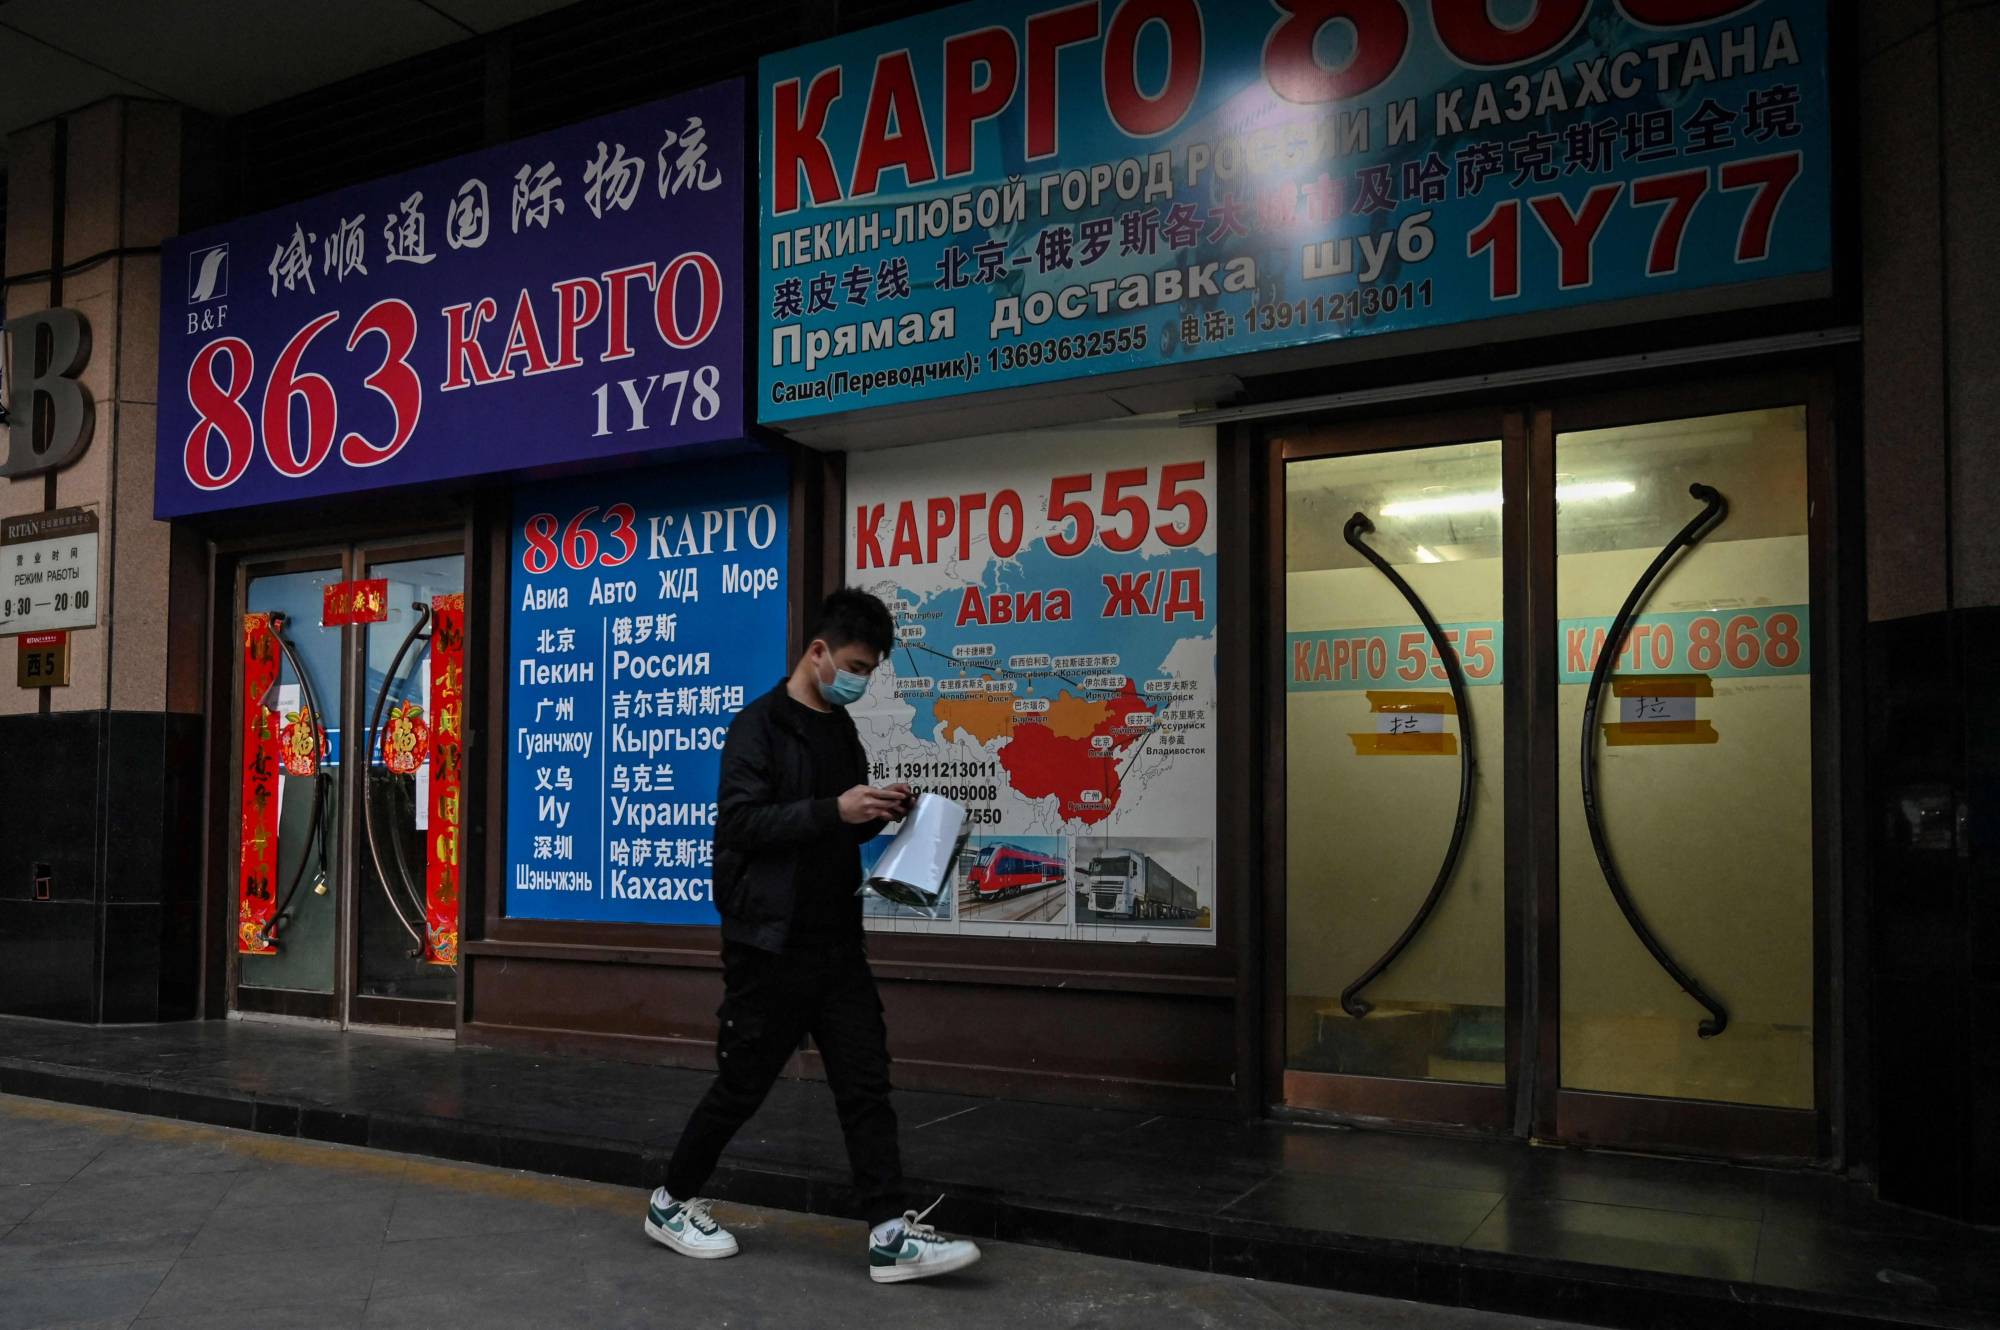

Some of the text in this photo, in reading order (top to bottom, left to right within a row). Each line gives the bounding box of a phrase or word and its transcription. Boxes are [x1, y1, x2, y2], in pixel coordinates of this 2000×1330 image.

[772, 0, 1205, 217] КАРГО
[771, 173, 1026, 270] ПЕКИН-ЛЮБОЙ
[1039, 149, 1174, 217] ГОРОД
[1386, 97, 1418, 147] И
[1435, 18, 1800, 137] КАЗАХСТАНА
[268, 116, 723, 297] 俄顺通国际物流
[1467, 150, 1803, 301] 1Y77
[771, 209, 1437, 372] Прямая доставка шуб
[772, 256, 910, 320] 裘皮专线
[1243, 279, 1434, 336] 13911213011
[986, 325, 1148, 373] 13693632555
[183, 250, 724, 491] 863 КАРГО
[590, 365, 721, 437] 1Y78
[856, 460, 1209, 570] КАРГО 555
[522, 503, 777, 574] 863 КАРГО
[16, 547, 78, 567] 营业时间
[15, 567, 80, 586] РЕЖИМ РАБОТЫ
[521, 564, 779, 612] Авиа Авто Ж/Д Море
[955, 567, 1205, 628] Авиа Ж/Д
[536, 628, 576, 654] 北京
[612, 613, 677, 646] 俄罗斯
[1687, 612, 1800, 671] 868
[520, 659, 594, 686] Пекин
[613, 651, 710, 680] Россия
[1294, 628, 1494, 682] КАРГО 555
[535, 696, 574, 723] 广州
[612, 685, 744, 719] 吉尔吉斯斯坦
[518, 727, 593, 760] Гуанчжоу
[612, 722, 729, 759] Кыргыэс
[1146, 746, 1207, 757] Владивосток
[534, 765, 573, 792] 义乌
[611, 764, 675, 793] 乌克兰
[895, 761, 996, 778] 13911213011
[911, 785, 998, 801] 911909008
[538, 795, 571, 829] Иу
[611, 796, 718, 833] Украина
[533, 835, 573, 861] 深圳
[516, 863, 593, 892] Шэньчжэнь
[611, 869, 714, 902] Кахахст
